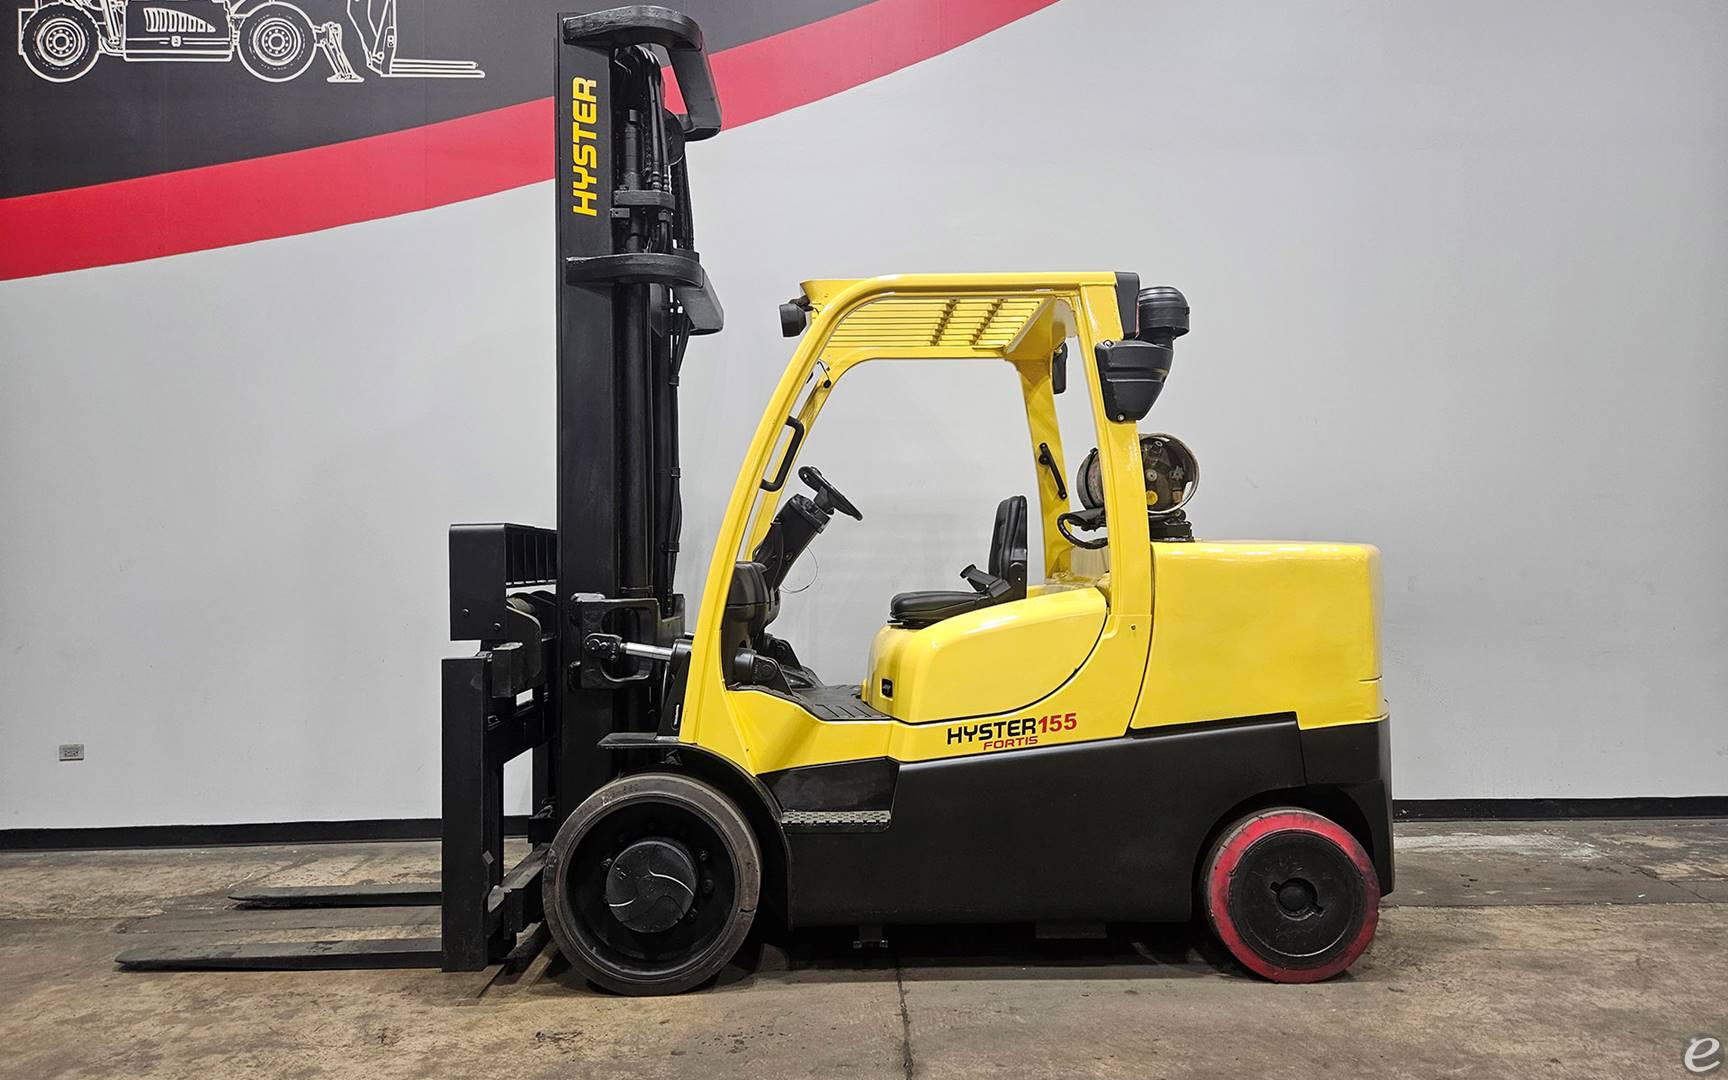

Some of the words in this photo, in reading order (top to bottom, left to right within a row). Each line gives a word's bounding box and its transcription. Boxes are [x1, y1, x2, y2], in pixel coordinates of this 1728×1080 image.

[572, 76, 598, 217] HYSTER
[947, 717, 1036, 745] HYSTER
[1037, 713, 1077, 733] 155
[983, 735, 1038, 750] FORTIS
